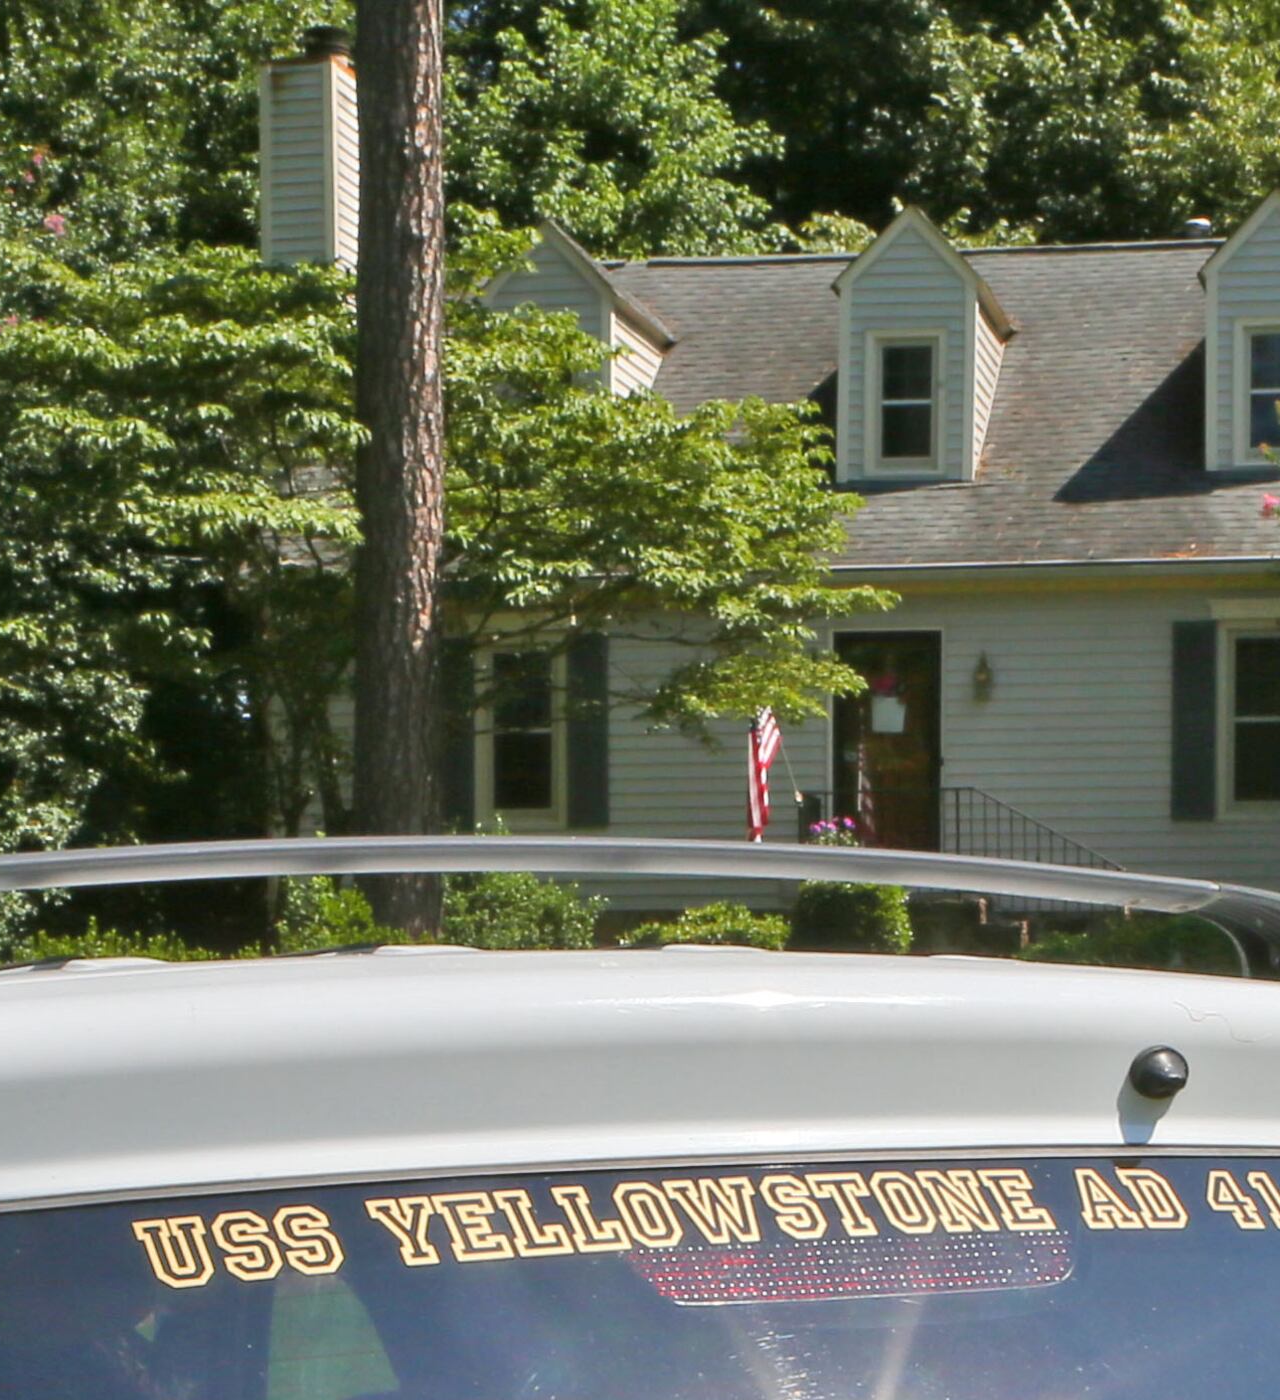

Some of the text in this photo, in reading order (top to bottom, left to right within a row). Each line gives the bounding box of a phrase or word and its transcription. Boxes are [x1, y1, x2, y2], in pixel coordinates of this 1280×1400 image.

[131, 1204, 344, 1289] USS
[365, 1168, 1057, 1266] YELLOWSTONE
[1074, 1167, 1188, 1229] AD
